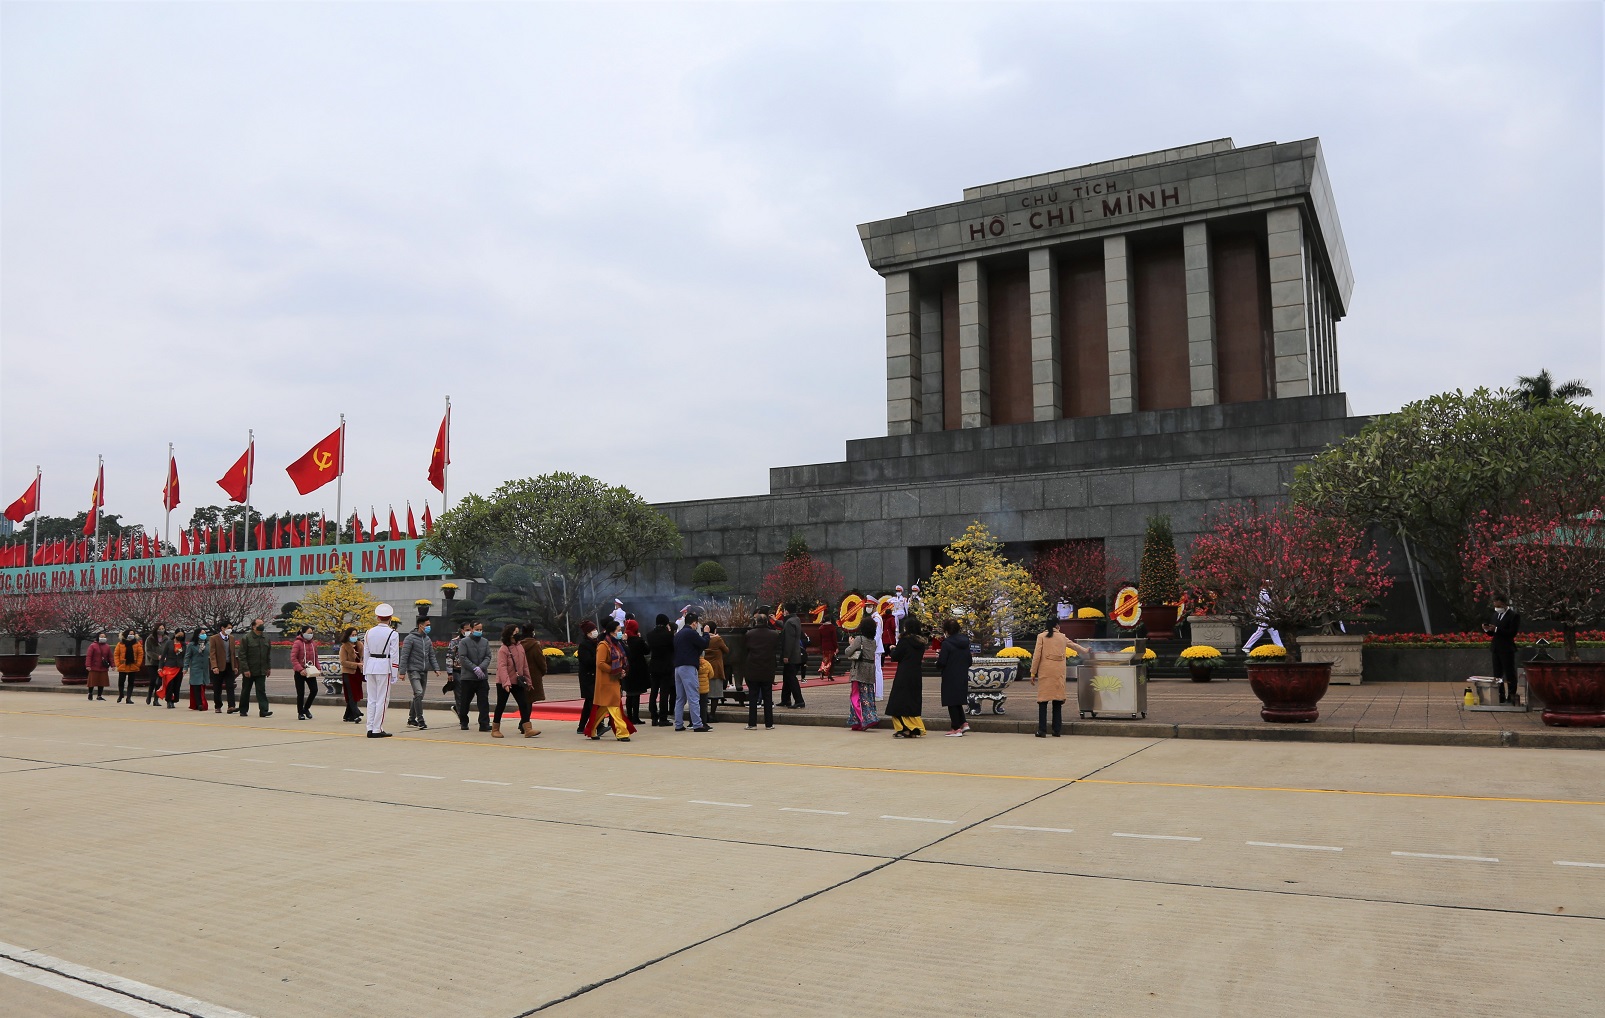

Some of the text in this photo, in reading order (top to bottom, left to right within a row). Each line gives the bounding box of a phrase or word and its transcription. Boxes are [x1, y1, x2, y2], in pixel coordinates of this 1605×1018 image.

[51, 567, 75, 588] HÒA
[80, 565, 96, 587] XÃ
[129, 559, 155, 584] CHỦ
[161, 557, 207, 584] NGHĨA
[254, 555, 292, 578] NAM
[300, 548, 353, 576] MUÔN
[361, 544, 406, 573] NĂM
